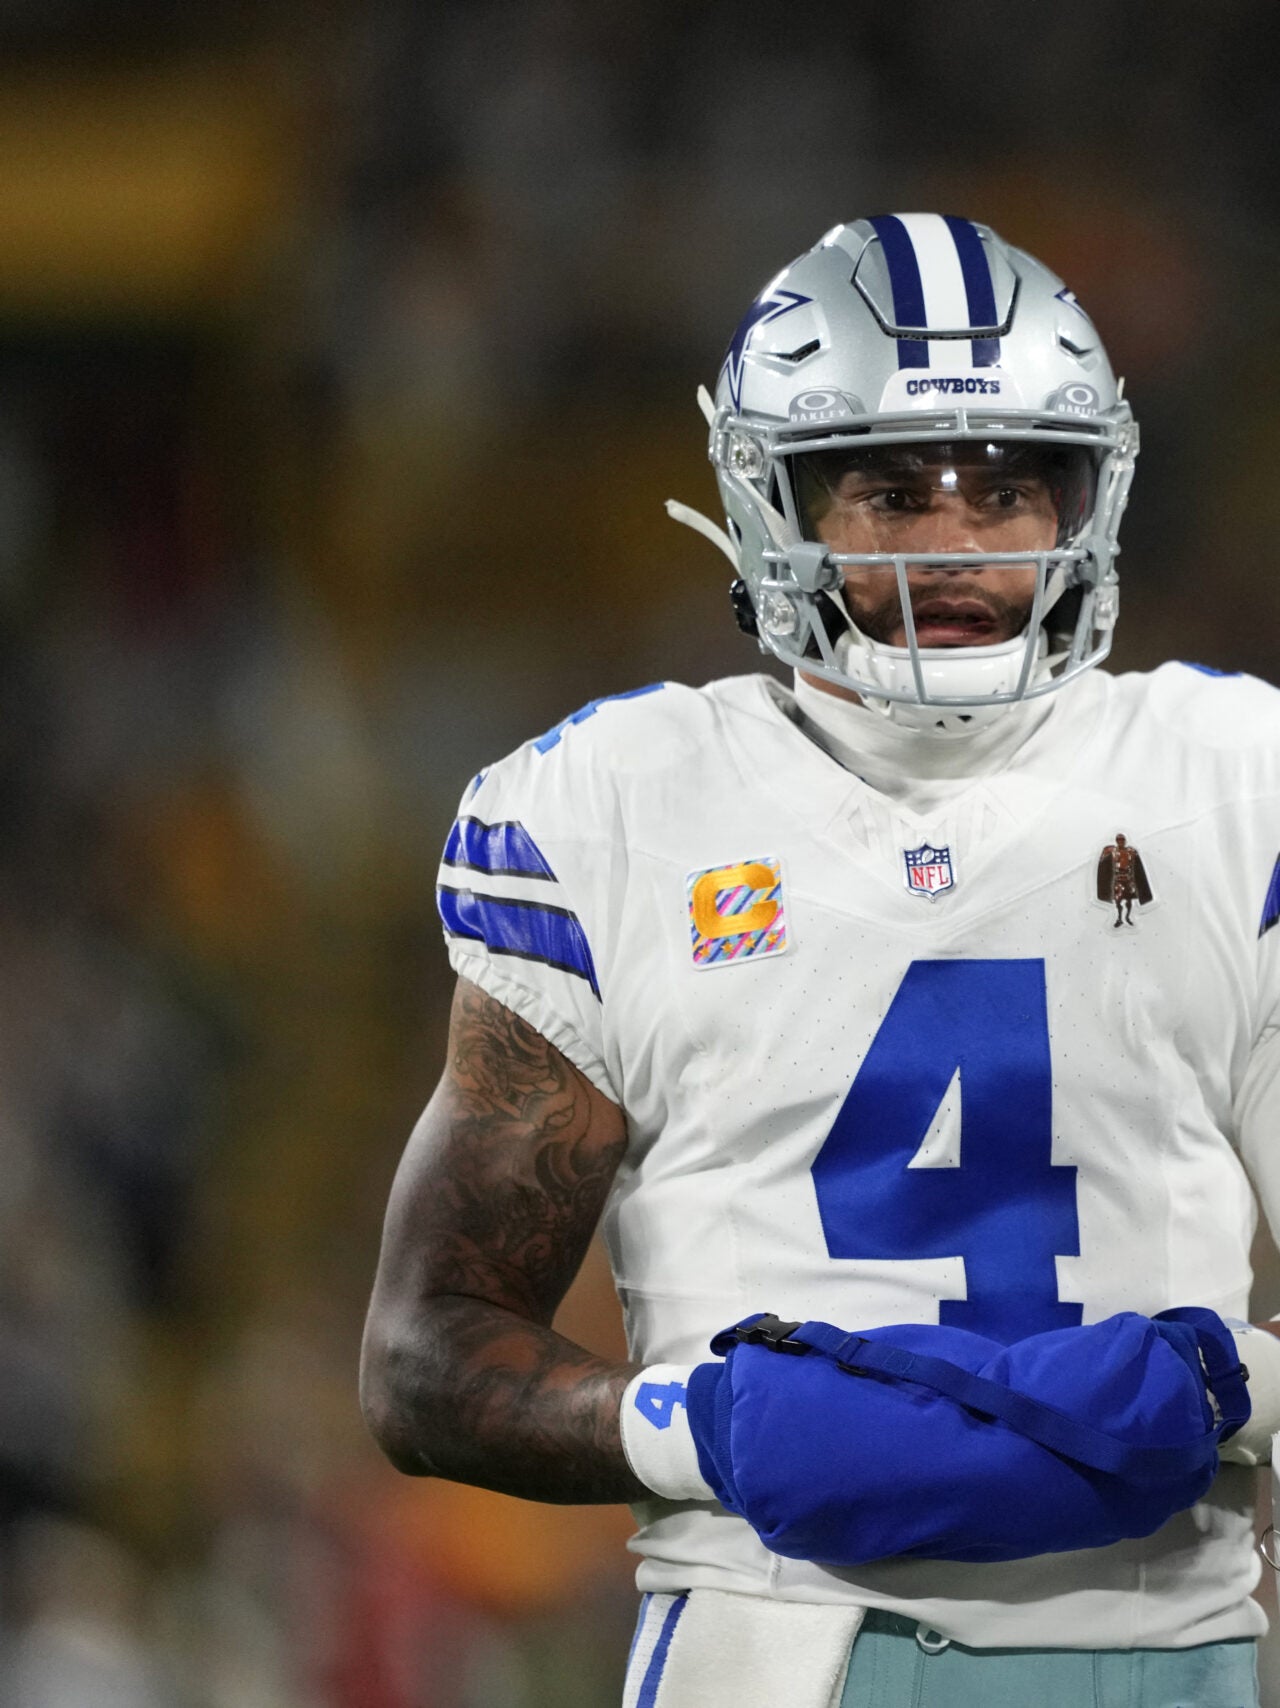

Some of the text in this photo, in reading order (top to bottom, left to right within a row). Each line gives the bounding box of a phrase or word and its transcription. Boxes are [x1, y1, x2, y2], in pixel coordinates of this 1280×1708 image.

[907, 378, 1000, 396] COWBOYS
[790, 409, 846, 422] OAKLEY
[911, 865, 949, 889] NFL
[692, 863, 778, 939] C
[811, 958, 1085, 1347] 4
[635, 1381, 688, 1431] 4
